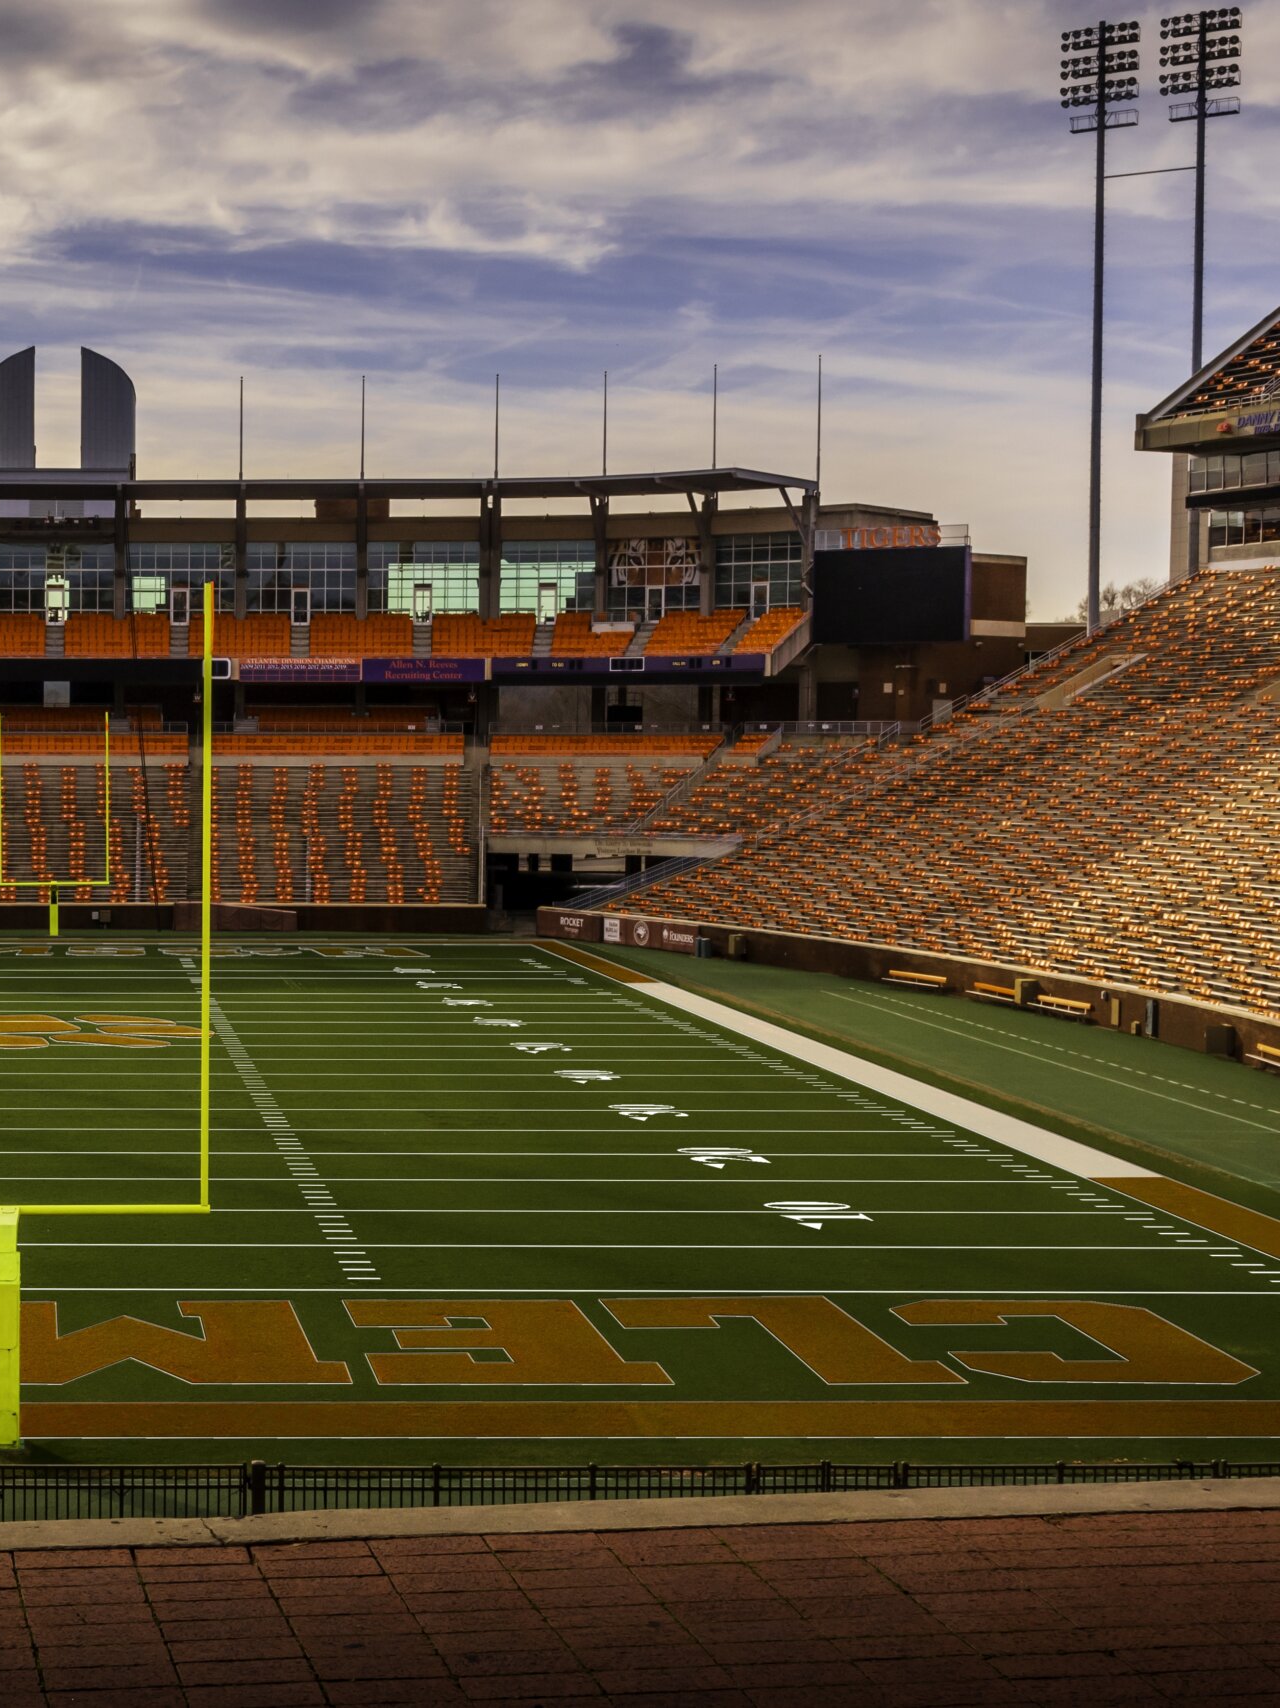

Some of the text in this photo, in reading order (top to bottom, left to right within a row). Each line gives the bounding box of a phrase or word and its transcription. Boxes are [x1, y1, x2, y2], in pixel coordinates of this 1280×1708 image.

[1237, 411, 1276, 428] DANNY
[841, 525, 942, 551] TIGERS
[389, 660, 458, 669] Allen N. Reeves
[384, 670, 463, 681] Recruiting Center
[560, 916, 584, 928] ROCKET
[669, 930, 694, 943] FOUNDERS
